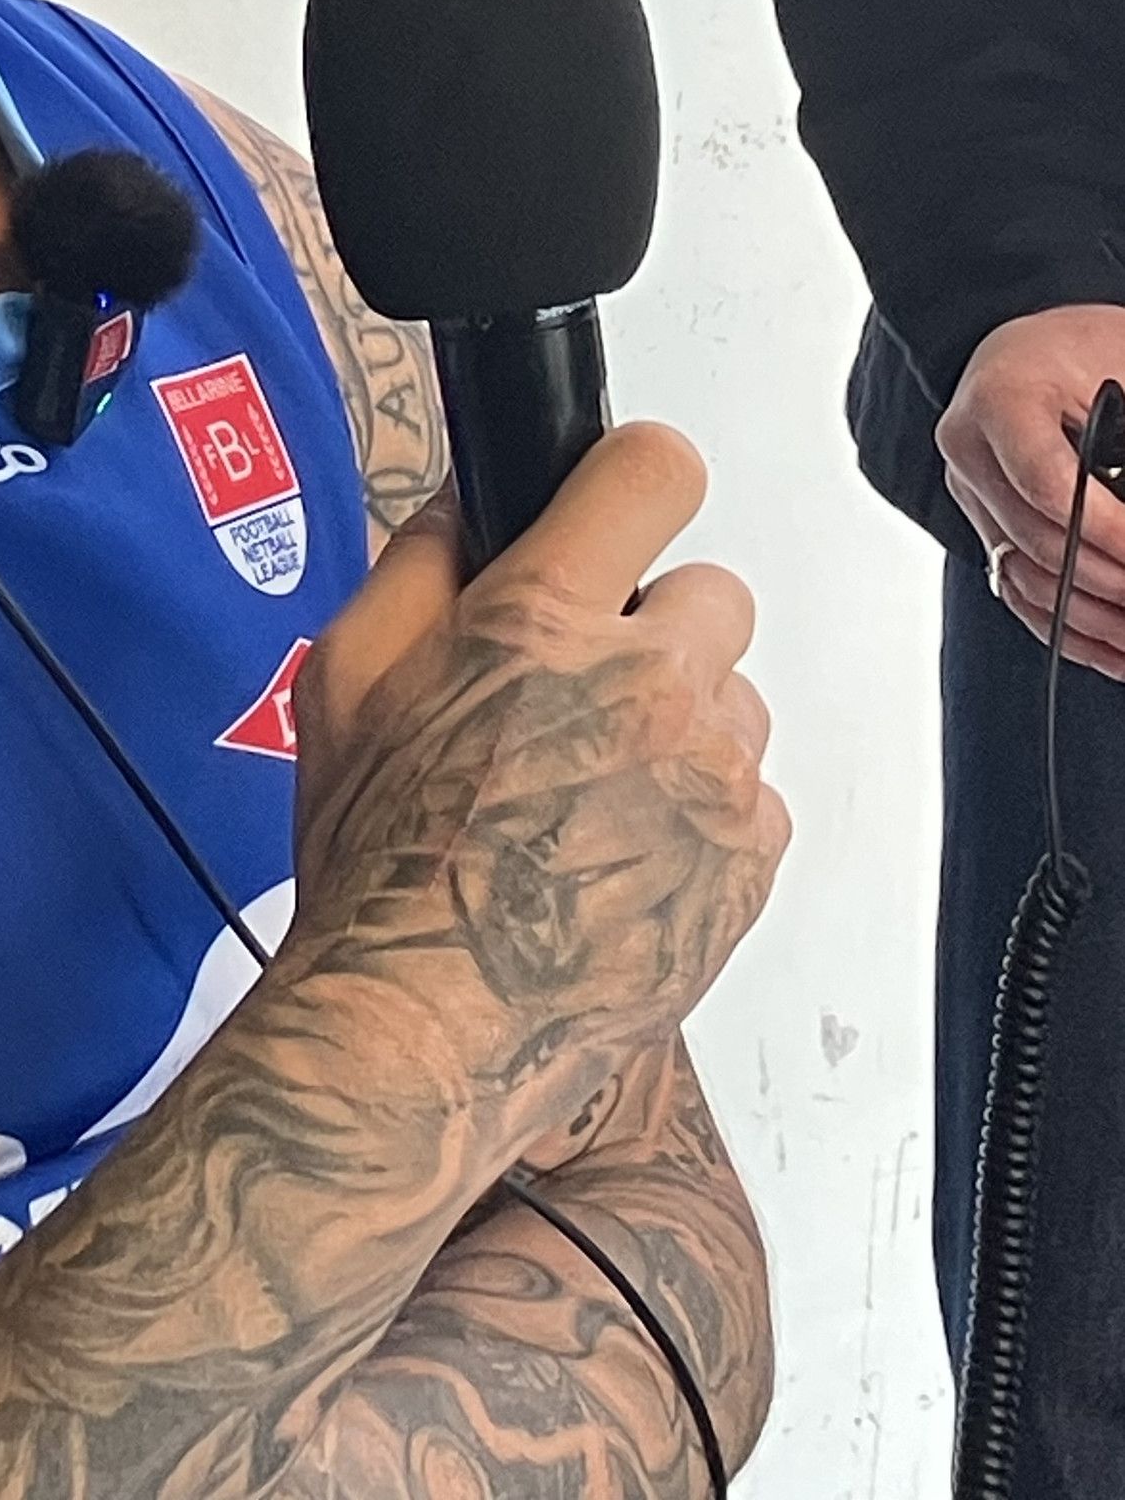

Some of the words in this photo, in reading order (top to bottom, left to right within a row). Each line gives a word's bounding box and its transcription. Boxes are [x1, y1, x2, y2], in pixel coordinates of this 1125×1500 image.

[229, 508, 295, 546] FOOTBALL
[241, 529, 298, 564] NETBALL
[251, 552, 302, 586] LEAGUE
